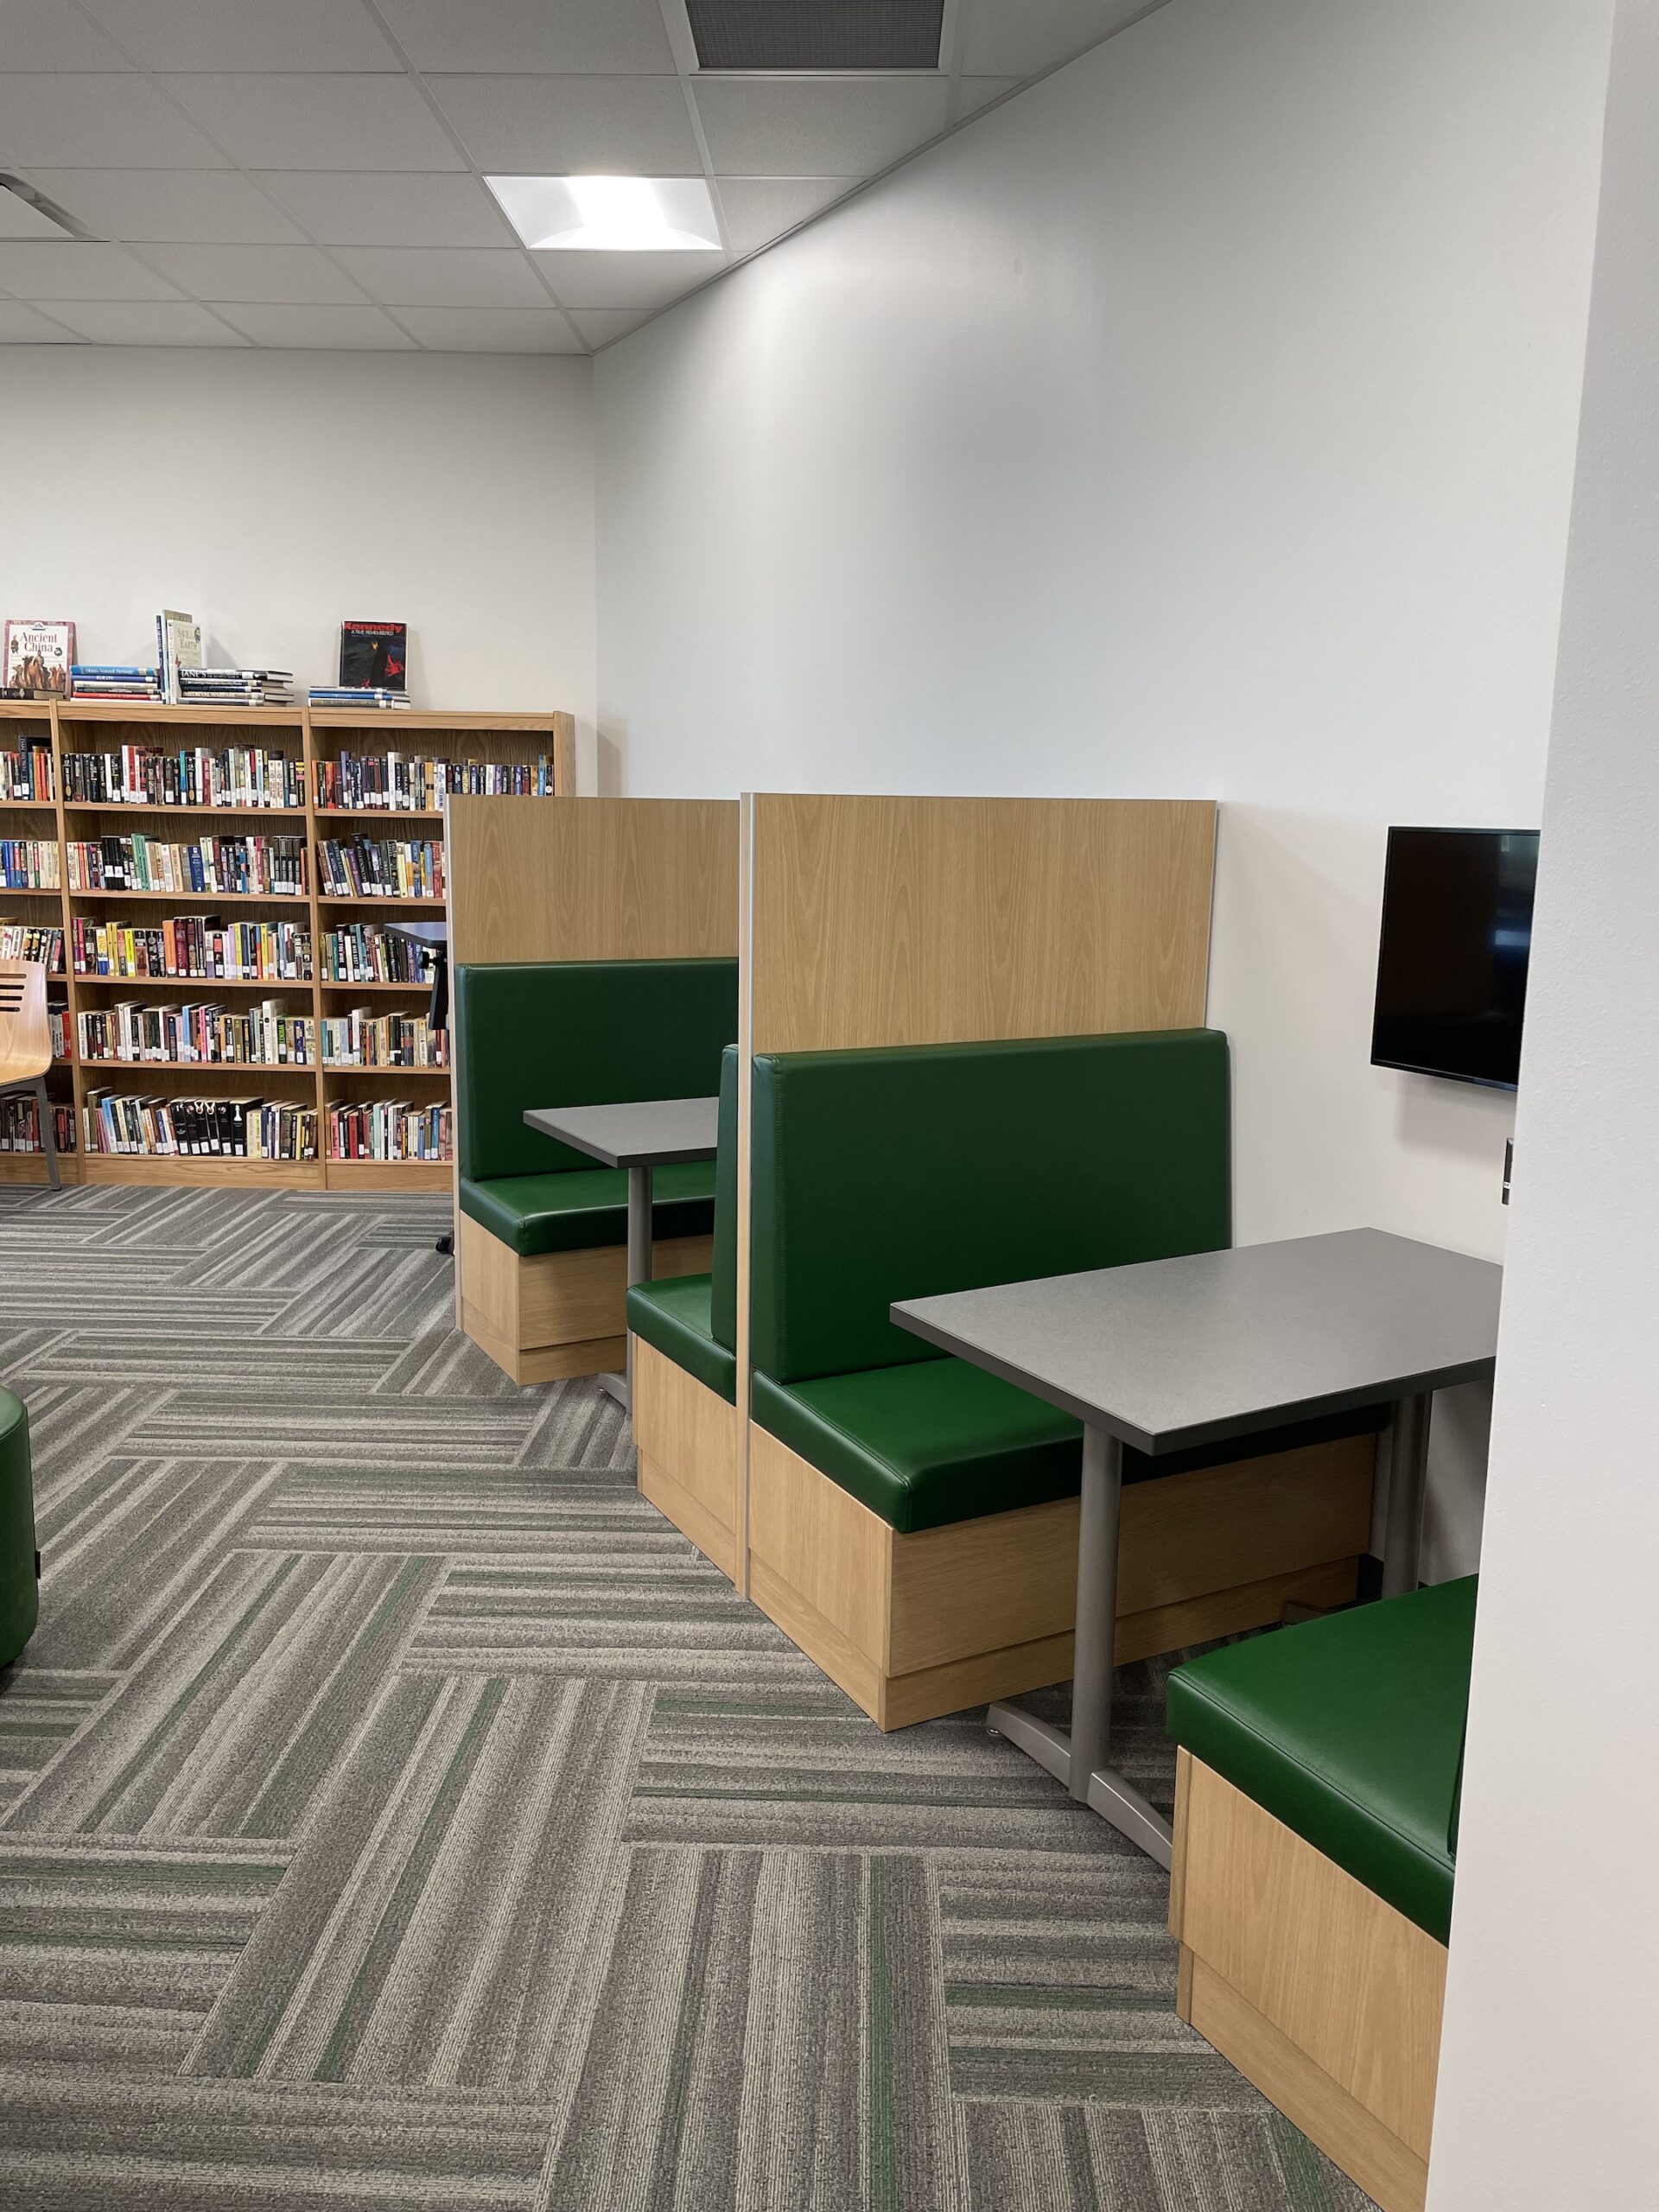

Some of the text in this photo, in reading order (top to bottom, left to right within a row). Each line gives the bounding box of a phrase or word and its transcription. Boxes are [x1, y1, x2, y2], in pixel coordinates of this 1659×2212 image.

[344, 622, 401, 633] Kennedy
[20, 632, 57, 643] Ancient
[24, 642, 54, 652] China
[181, 670, 207, 678] JANE'S
